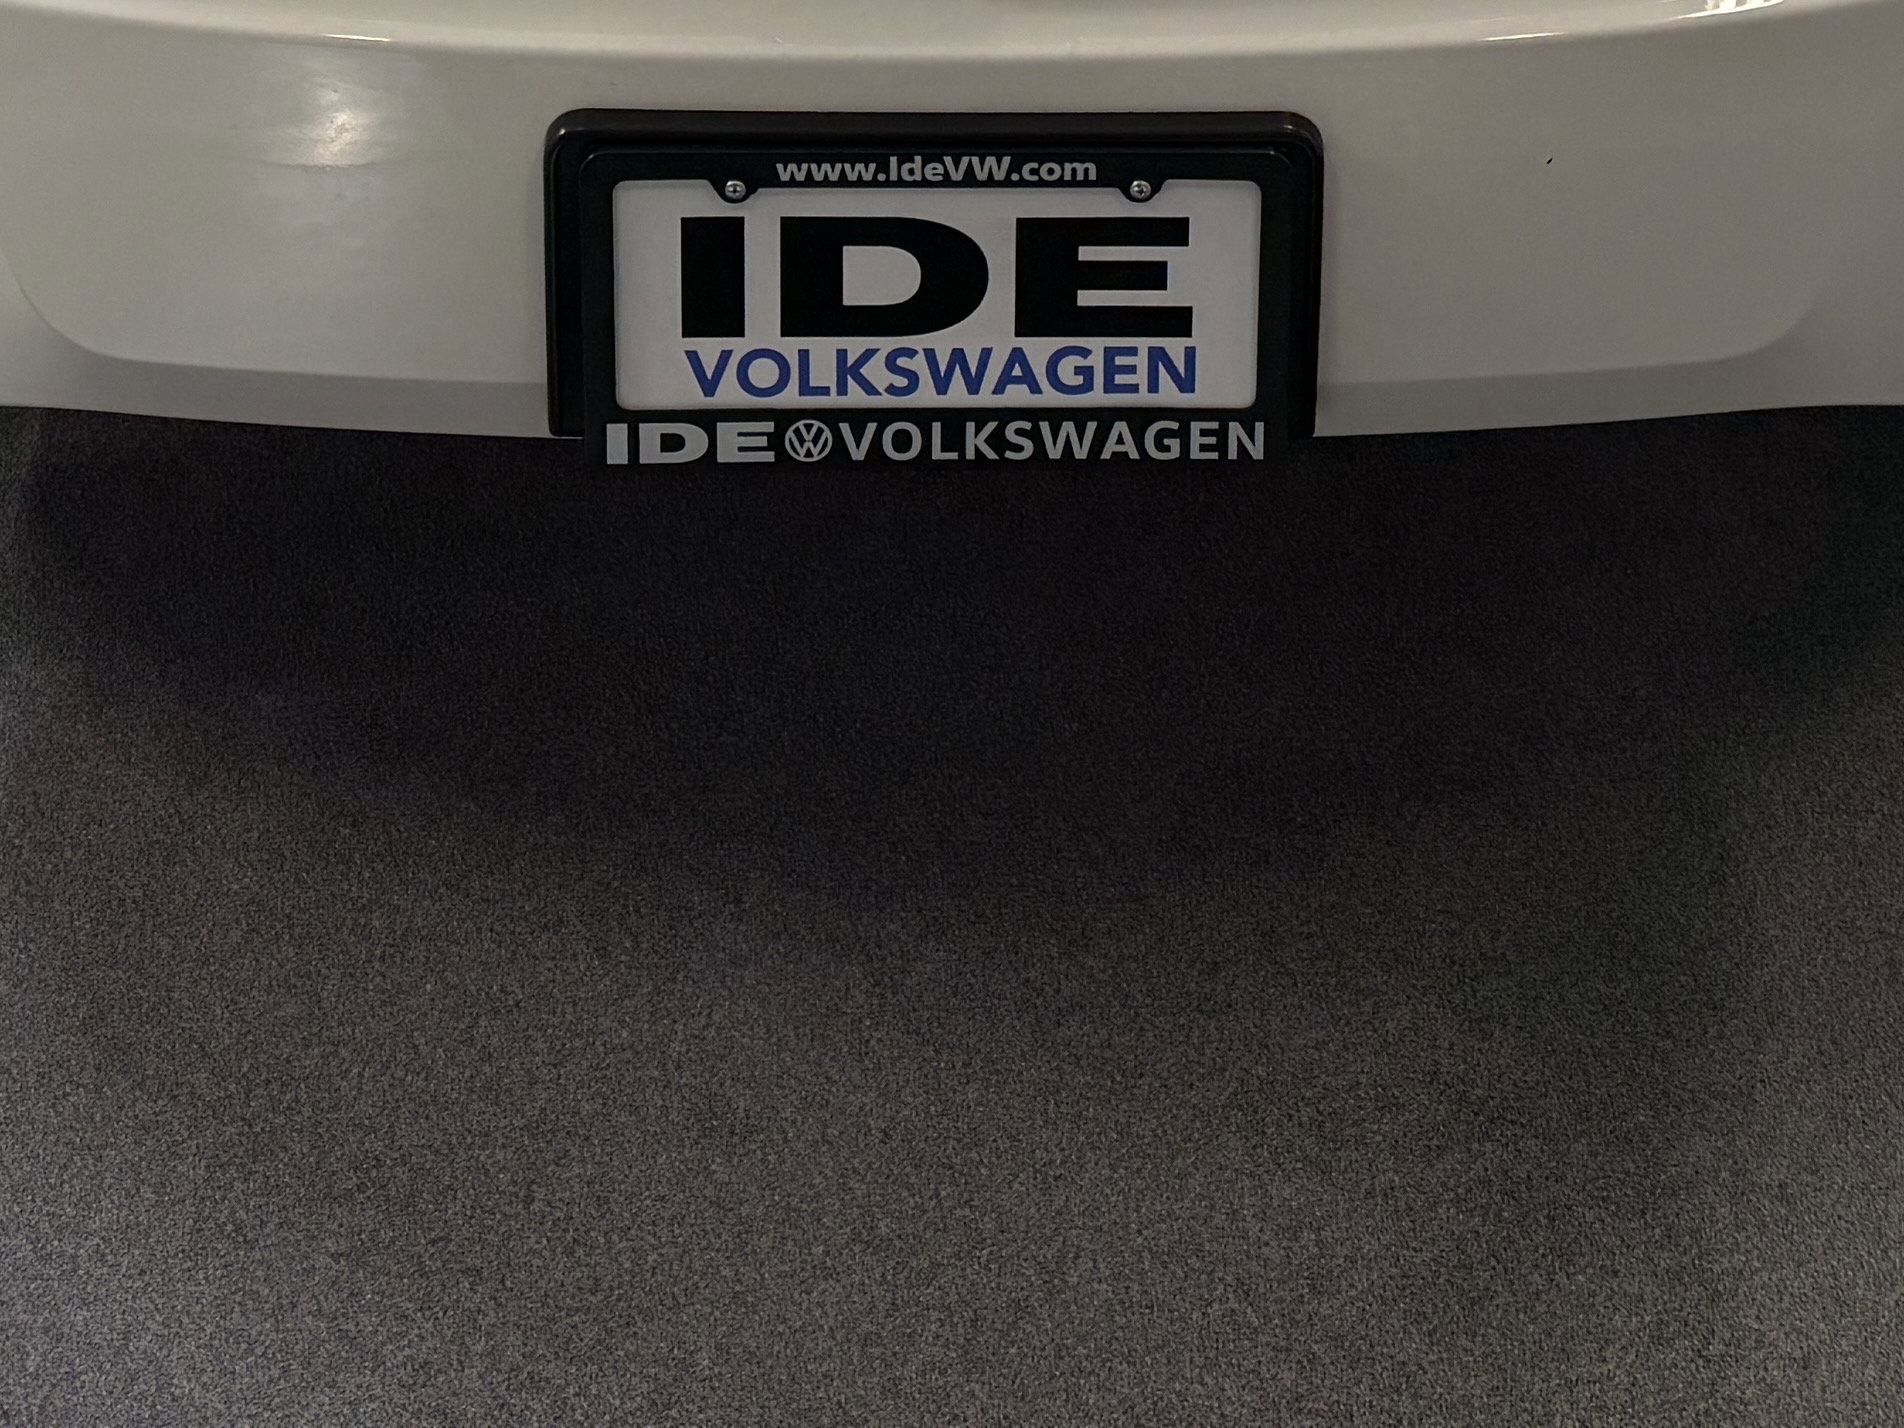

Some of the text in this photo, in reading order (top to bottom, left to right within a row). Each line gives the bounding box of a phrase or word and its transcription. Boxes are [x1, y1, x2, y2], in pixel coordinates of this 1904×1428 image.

[775, 154, 1098, 183] www.IdeVW.com
[679, 216, 1194, 338] IDE
[684, 346, 1197, 398] VOLKSWAGEN
[605, 420, 776, 465] IDE
[841, 419, 1265, 462] VOLKSWAGEN
